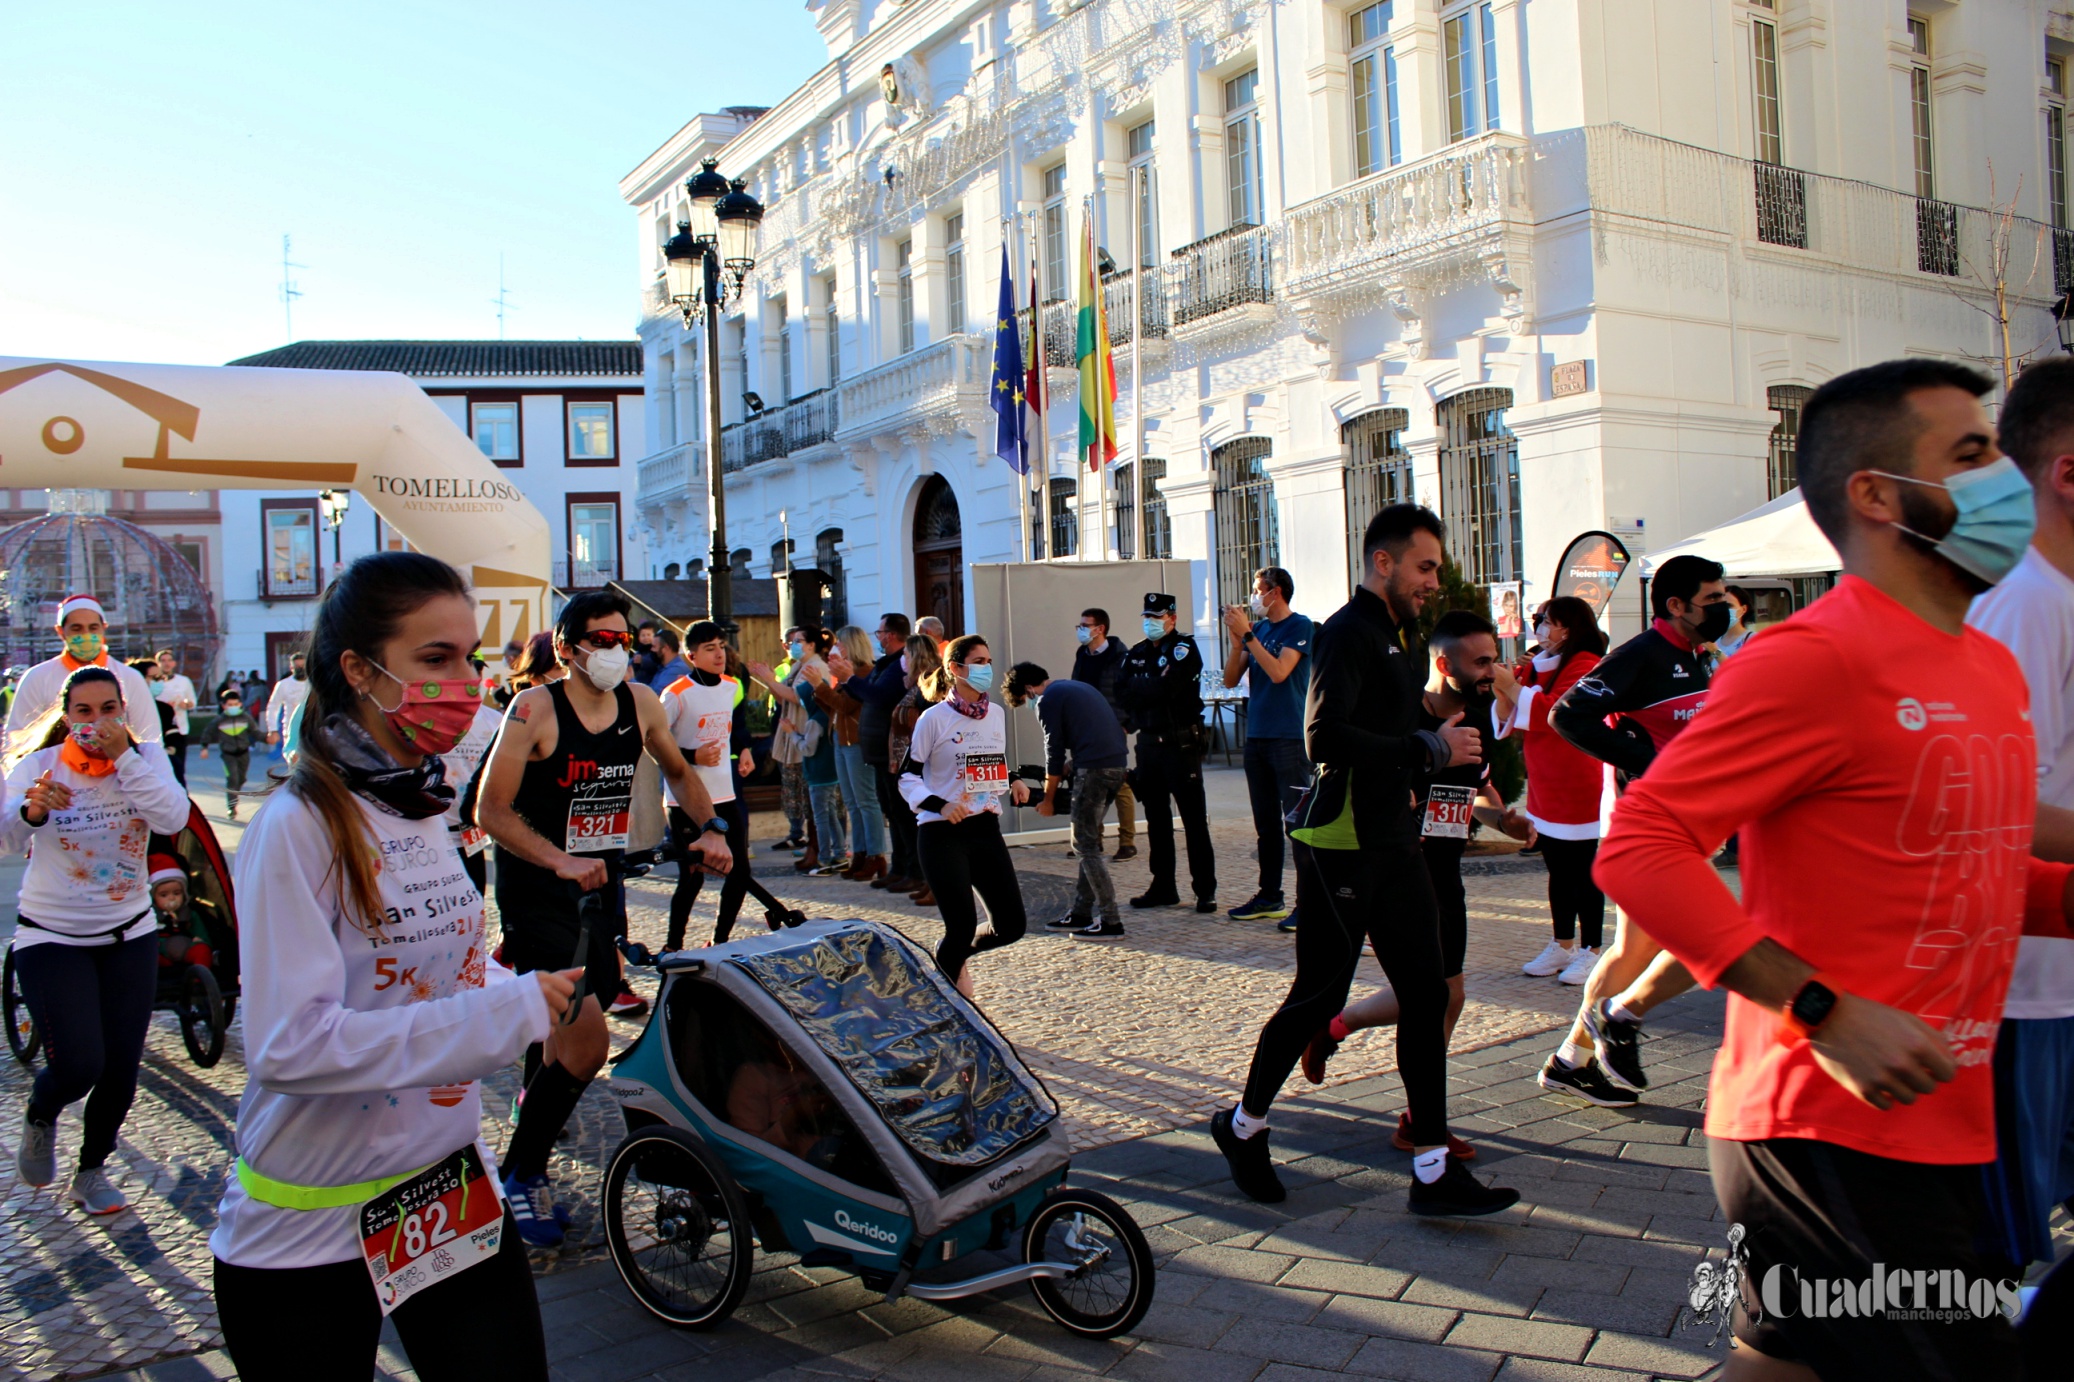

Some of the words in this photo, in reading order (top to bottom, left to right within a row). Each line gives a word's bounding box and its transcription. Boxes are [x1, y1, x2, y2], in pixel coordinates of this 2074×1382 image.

[373, 475, 521, 502] TOMELLOSO
[403, 501, 504, 512] AYUNTAMIENTO
[976, 766, 998, 781] 311
[55, 816, 80, 825] San
[581, 815, 615, 837] 321
[380, 835, 426, 854] GRUPO
[470, 827, 482, 843] 81
[384, 848, 439, 873] SURCO
[404, 881, 439, 894] GRUPO
[403, 1201, 458, 1259] 82
[471, 1225, 500, 1244] Pieles
[834, 1209, 898, 1244] Qeridoo
[393, 1266, 418, 1286] GRUPO
[397, 1271, 427, 1297] SURCO
